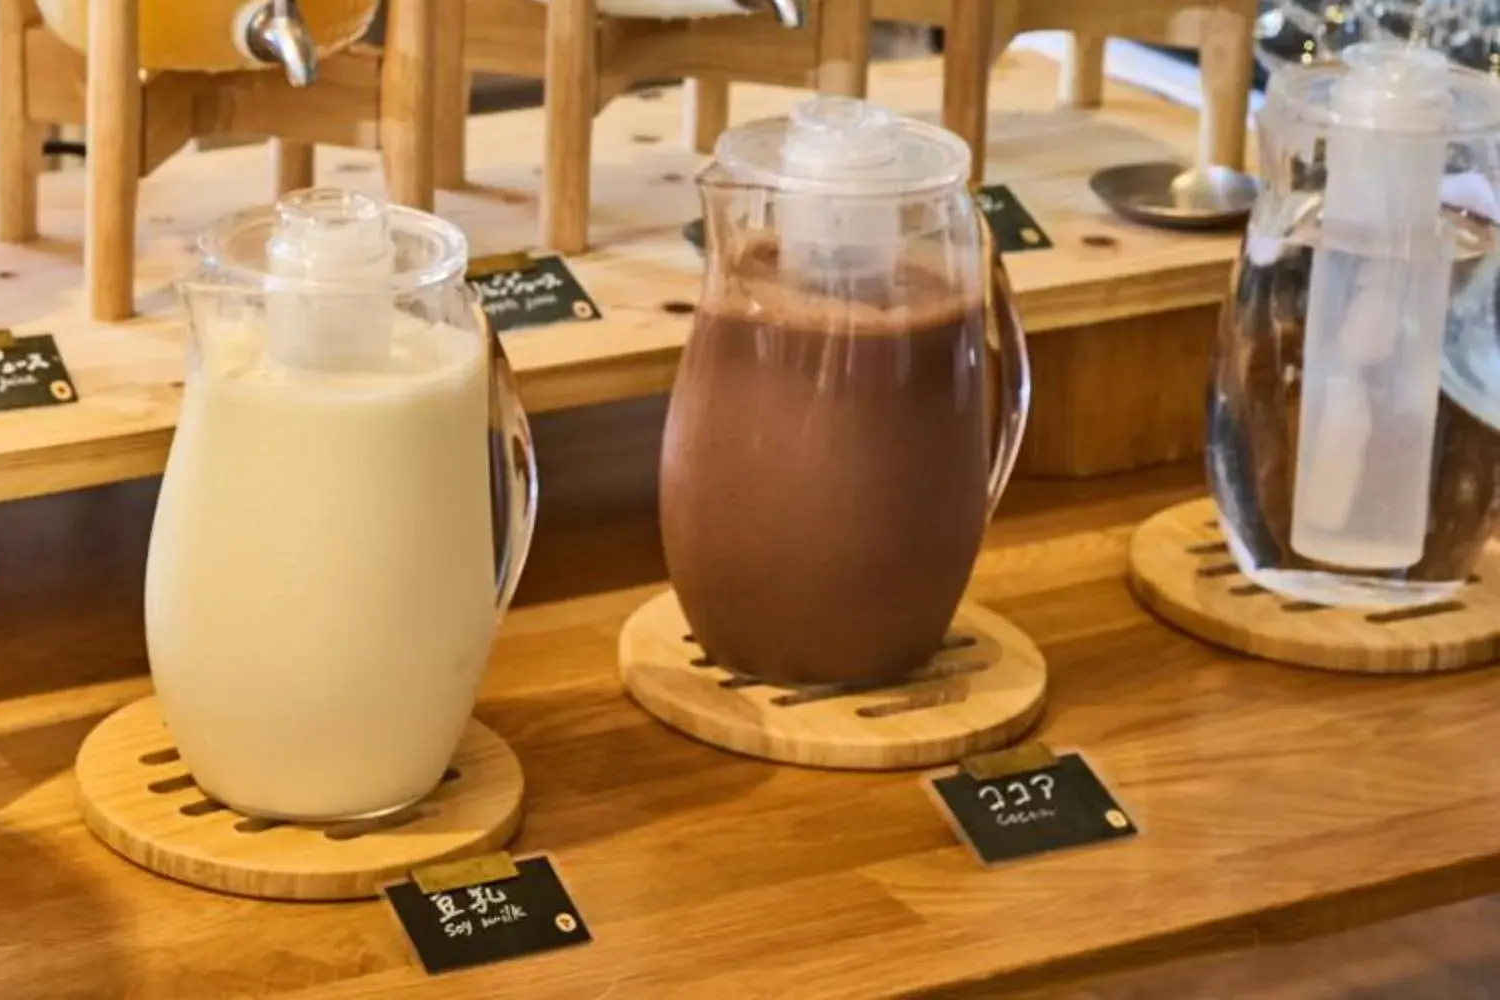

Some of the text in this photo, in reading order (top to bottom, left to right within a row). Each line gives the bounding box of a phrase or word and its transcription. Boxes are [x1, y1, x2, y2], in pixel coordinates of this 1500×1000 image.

[978, 774, 1055, 811] ココア
[430, 886, 508, 924] 豆乳
